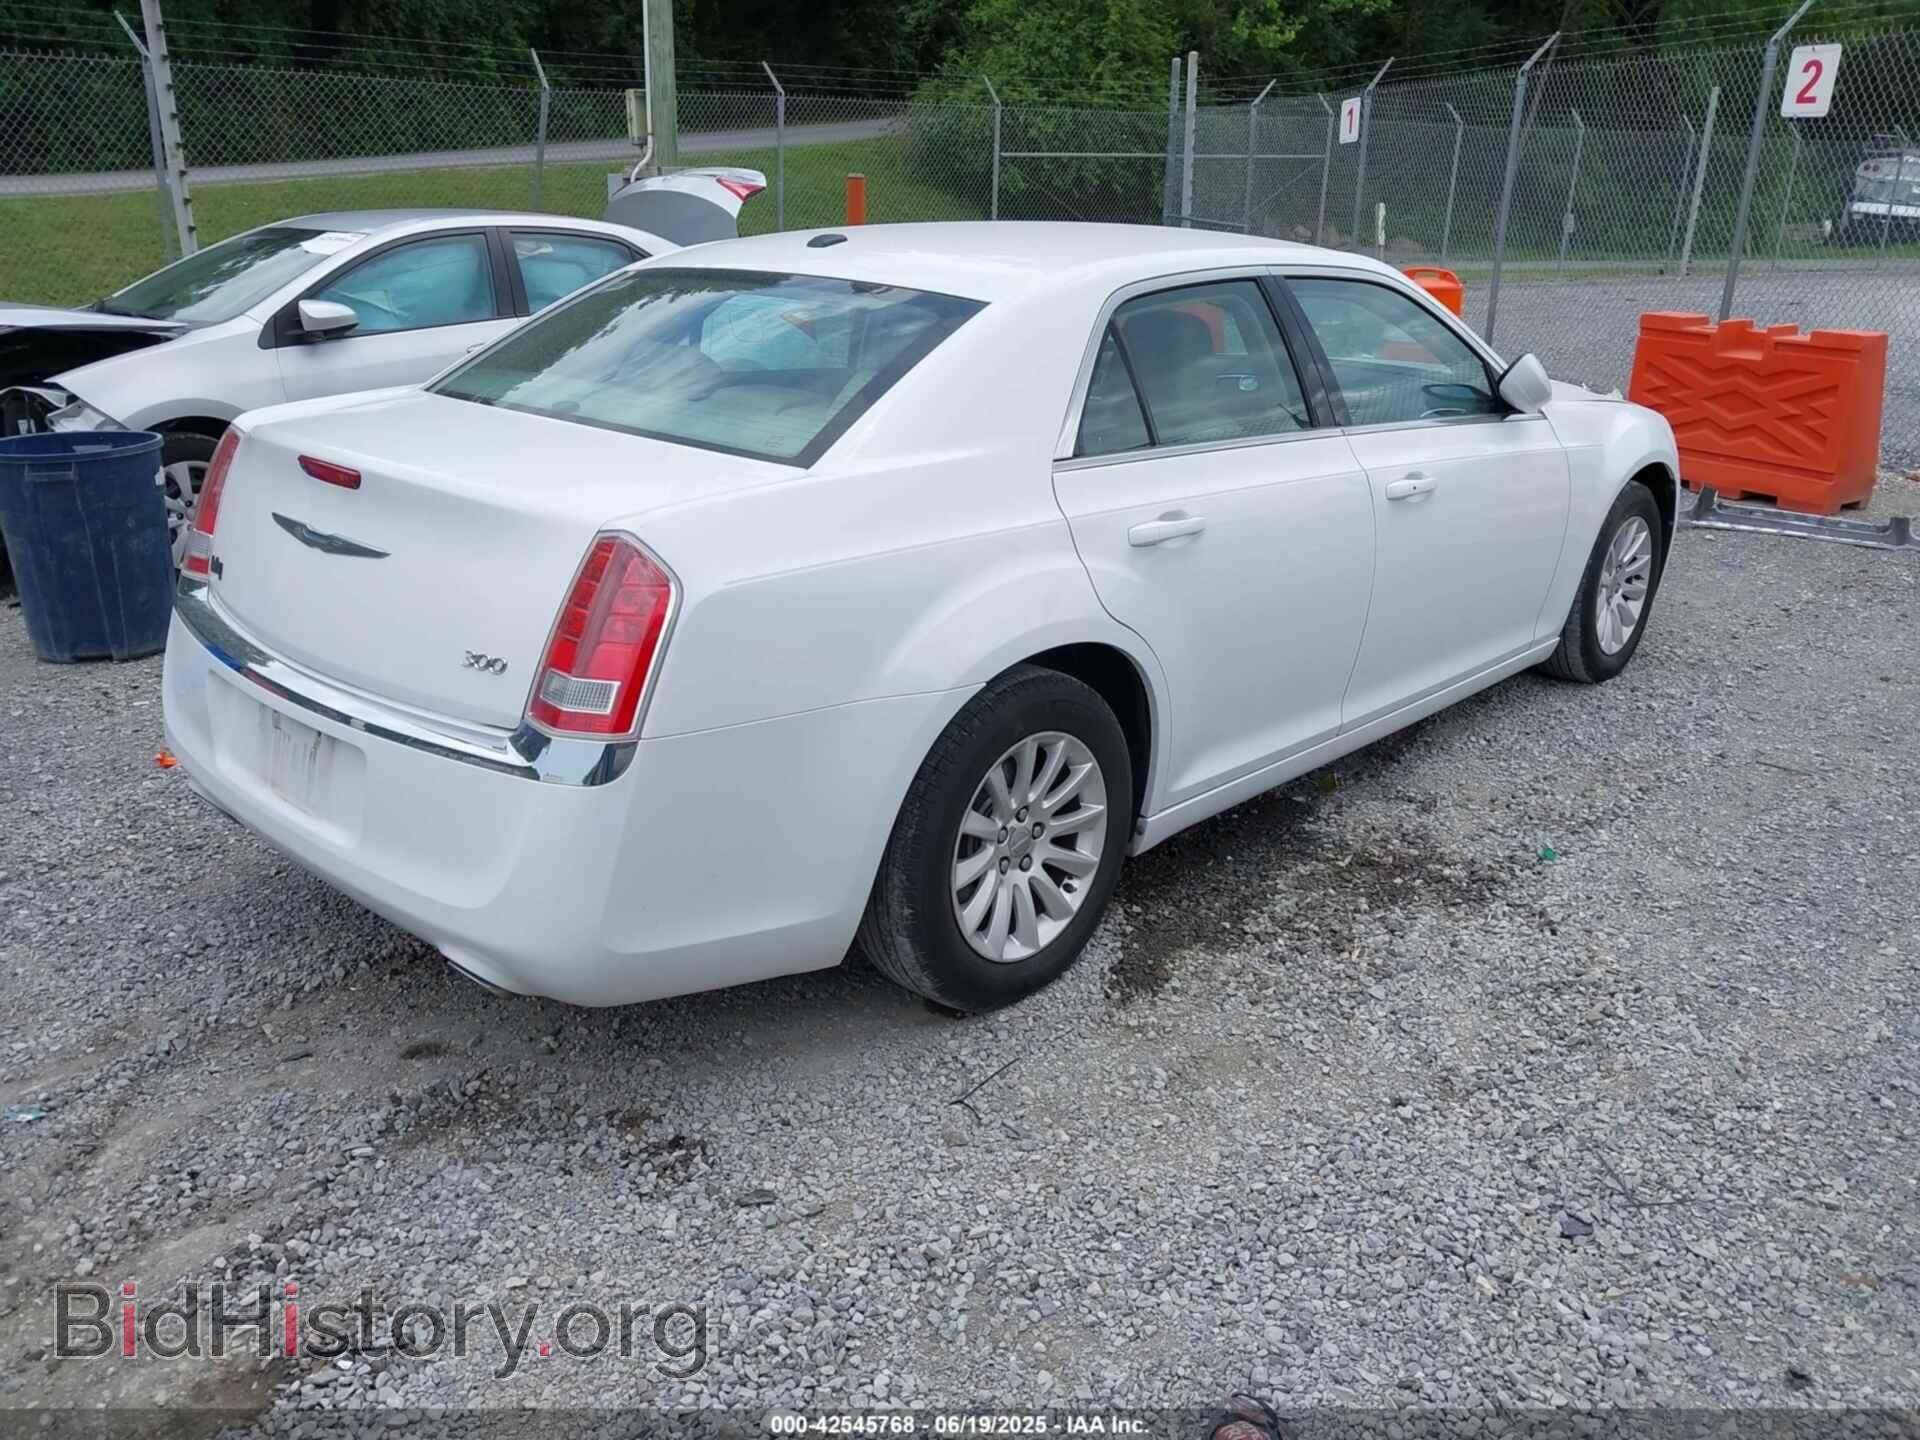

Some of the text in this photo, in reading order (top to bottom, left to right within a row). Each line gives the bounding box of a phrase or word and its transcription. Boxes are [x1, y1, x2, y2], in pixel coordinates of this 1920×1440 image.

[1795, 58, 1823, 104] 2
[1346, 105, 1354, 134] 1
[462, 650, 508, 676] 300
